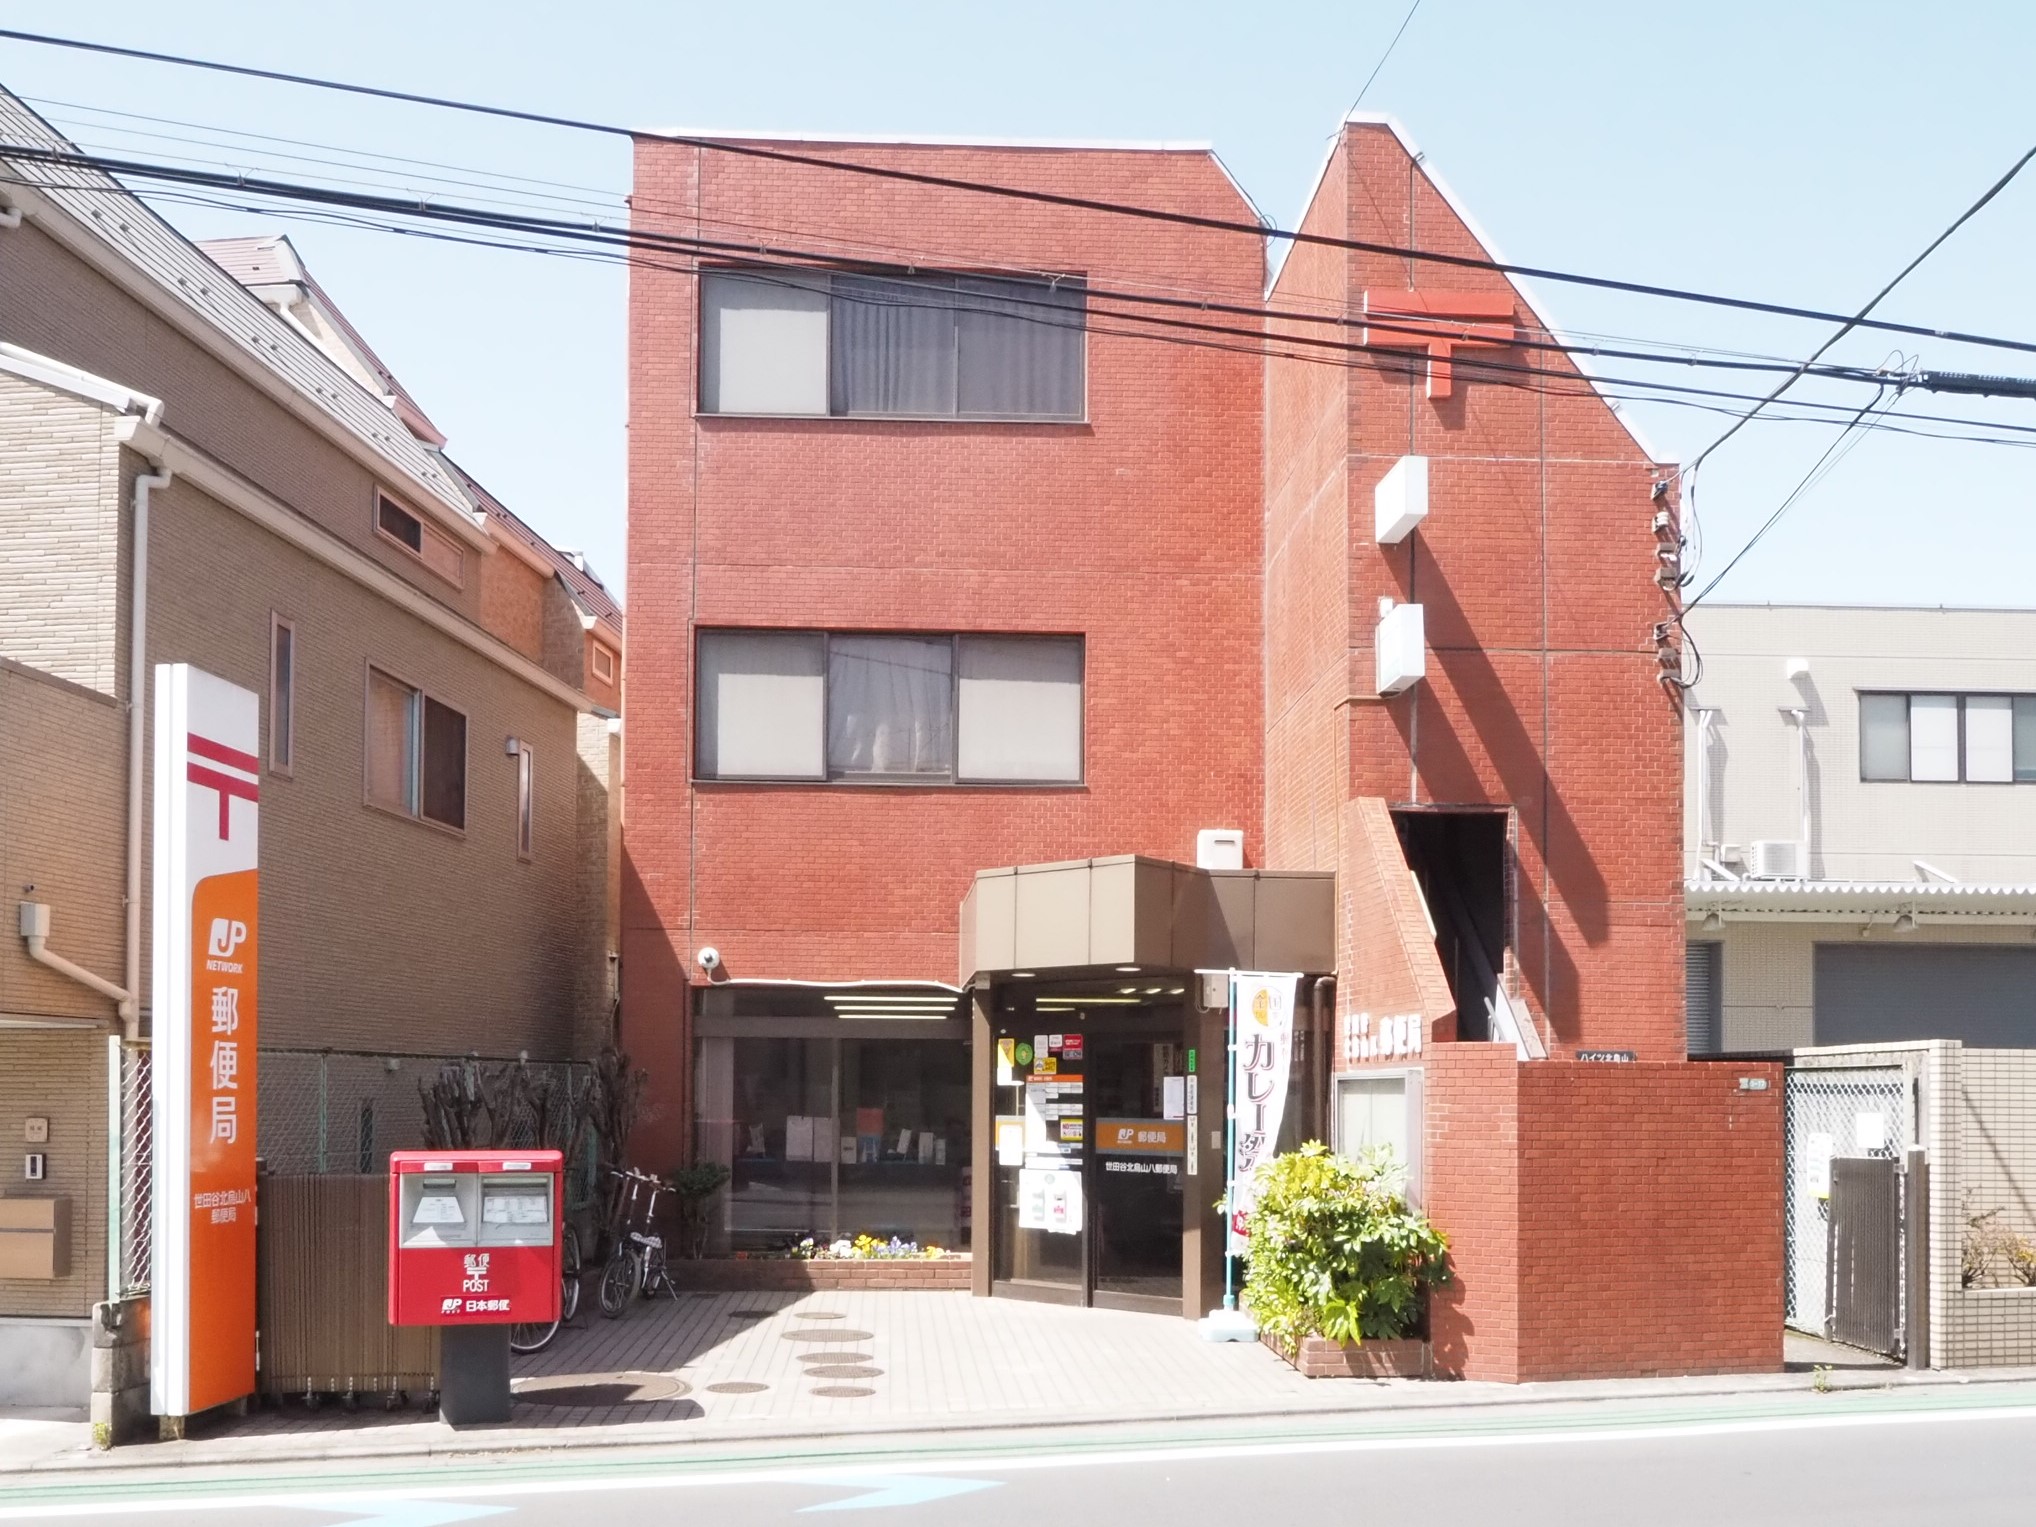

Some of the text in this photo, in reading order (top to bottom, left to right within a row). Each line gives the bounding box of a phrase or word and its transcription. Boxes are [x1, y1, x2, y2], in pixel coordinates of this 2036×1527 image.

[206, 959, 244, 974] NETWORK
[210, 986, 239, 1144] 郵便局
[211, 1206, 237, 1224] 郵便局
[463, 1253, 490, 1268] 郵便
[463, 1279, 490, 1293] POST
[466, 1299, 511, 1313] 日本郵便
